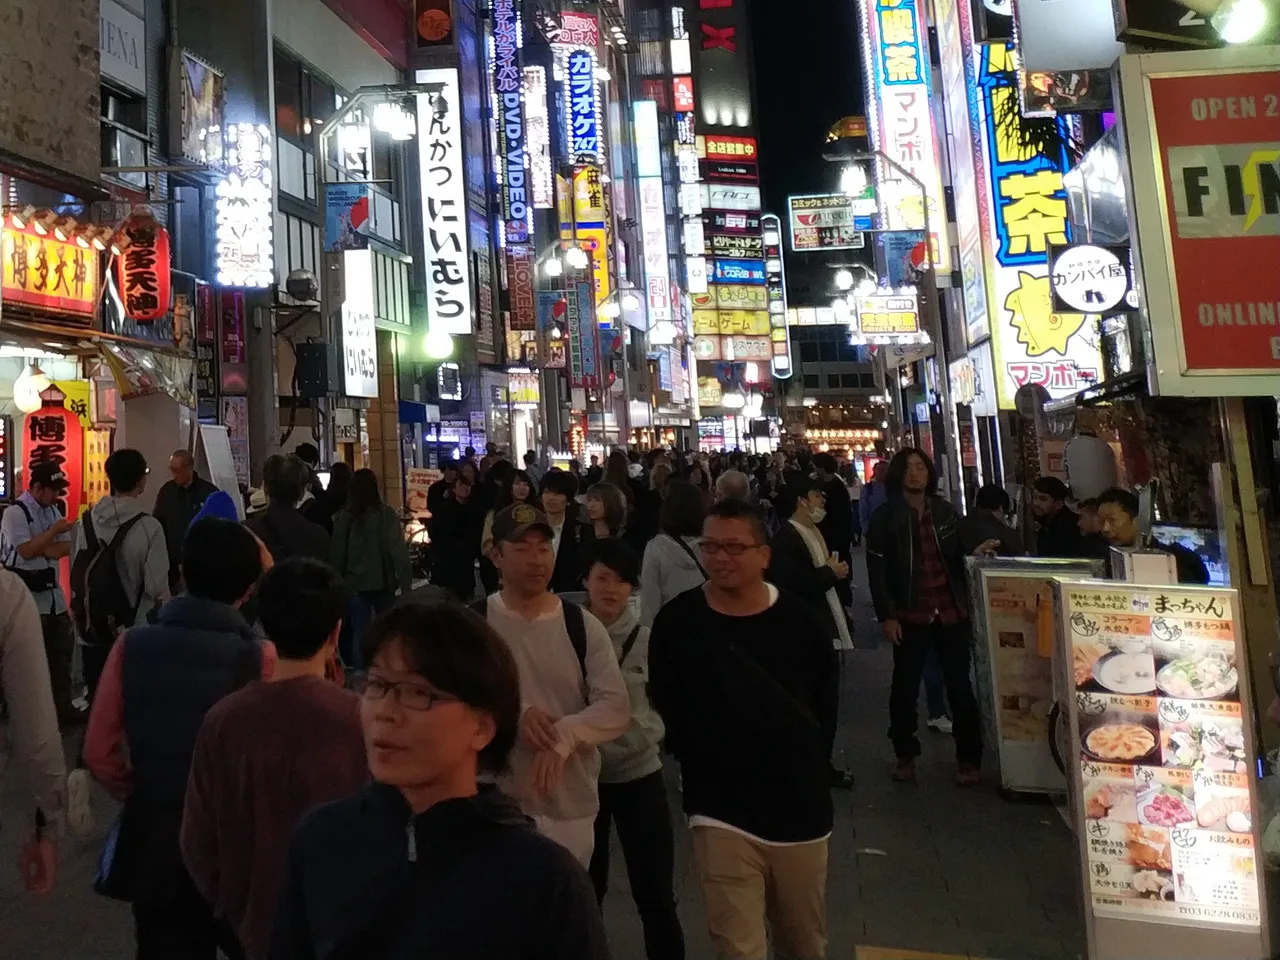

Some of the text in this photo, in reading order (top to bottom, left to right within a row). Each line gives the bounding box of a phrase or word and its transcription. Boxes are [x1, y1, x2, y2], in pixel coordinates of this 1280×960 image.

[571, 54, 596, 135] カラオケ
[1191, 97, 1256, 121] OPEN
[574, 136, 596, 150] 747
[587, 168, 602, 209] 麻雀
[428, 196, 465, 318] にいむら
[721, 319, 750, 330] ゲーム
[1198, 302, 1280, 327] ONLIN
[1155, 593, 1224, 618] まっちゃん
[1103, 615, 1142, 625] コラーゲン
[1104, 625, 1130, 633] 水炊き
[1184, 620, 1231, 631] 博多もつ鍋
